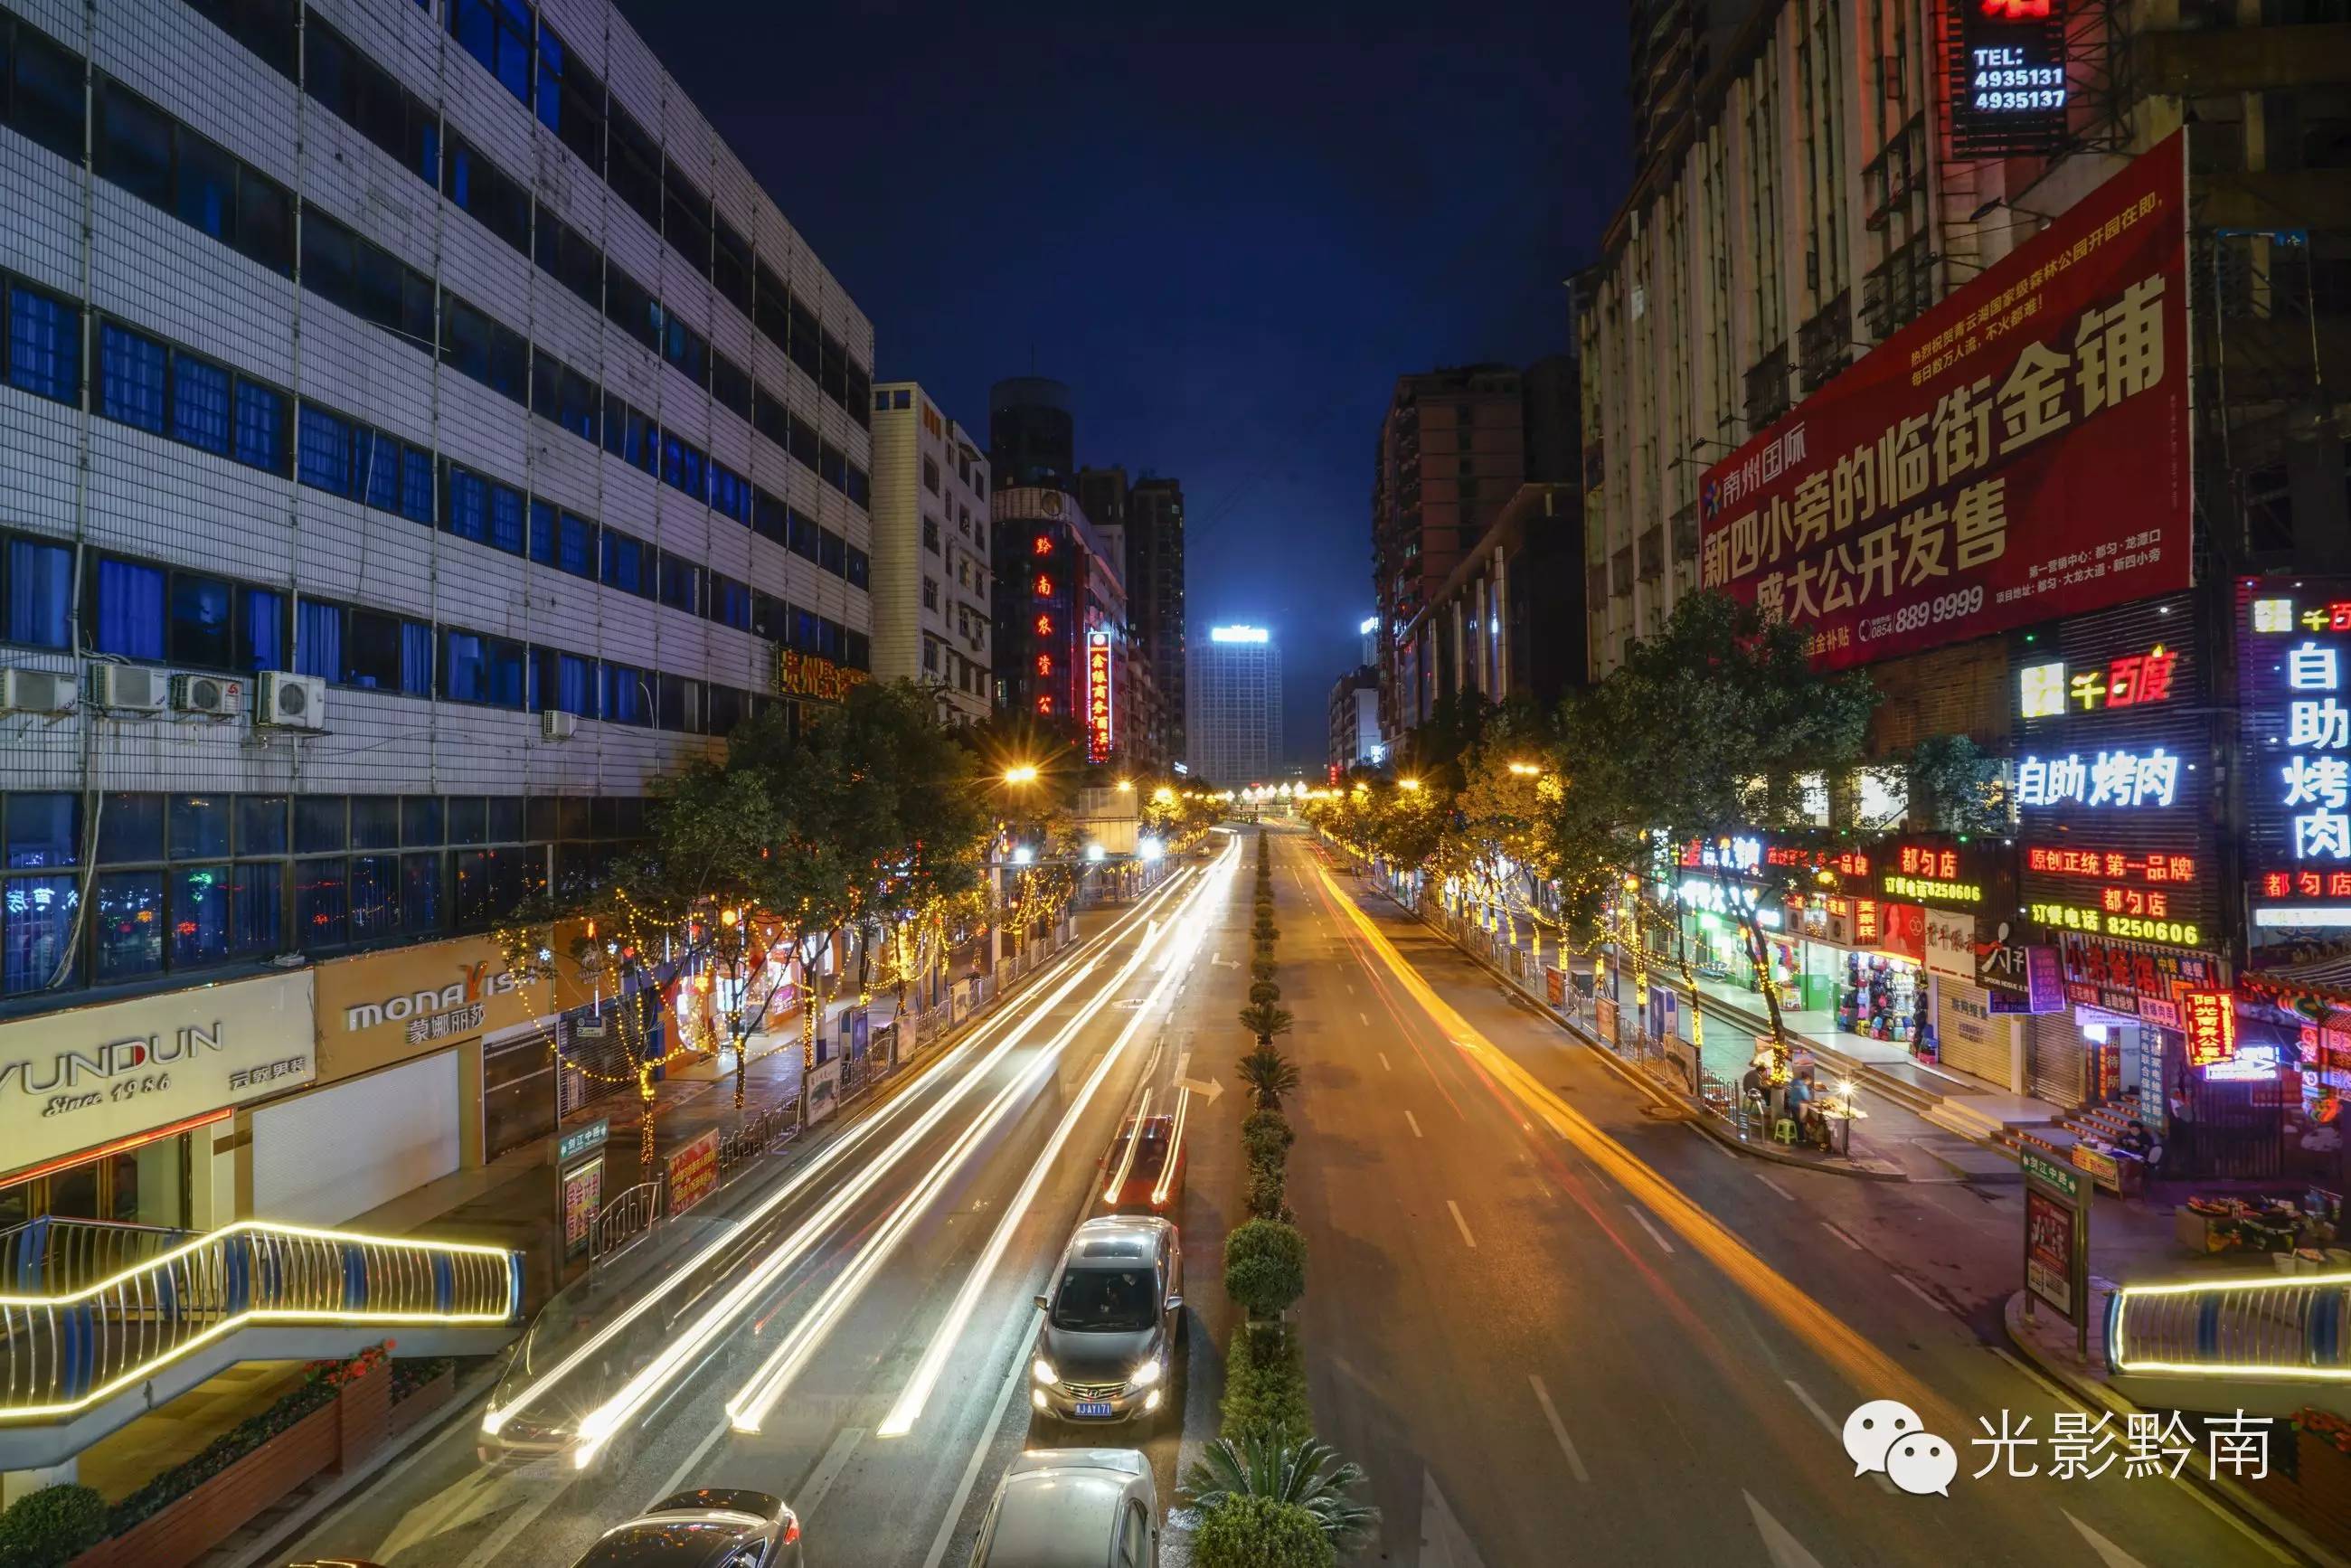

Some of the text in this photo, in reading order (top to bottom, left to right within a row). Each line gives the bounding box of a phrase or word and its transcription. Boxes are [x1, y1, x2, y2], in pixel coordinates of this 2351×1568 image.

[1974, 48, 2024, 66] TEL:
[1975, 68, 2063, 88] 4935131
[1976, 90, 2065, 109] 4935137
[1704, 272, 2167, 589] 新四小旁的临街金铺
[1723, 421, 1807, 508] 南州国际
[1757, 477, 2007, 626] 盛大公开发售
[1895, 604, 1930, 633] 889
[1932, 586, 1983, 622] 9999
[2071, 644, 2178, 710] 千百度
[2283, 642, 2350, 858] 自助烤肉
[2017, 748, 2178, 807] 自助烤肉
[1903, 846, 1959, 879] 都匀店
[2105, 888, 2167, 918] 都匀店
[2265, 873, 2351, 898] 都匀店
[2033, 903, 2199, 945] 订餐电话 8250606
[409, 1002, 486, 1045] 蒙娜丽莎
[230, 1056, 307, 1091] 云敦男装
[43, 1073, 172, 1118] Since 1986
